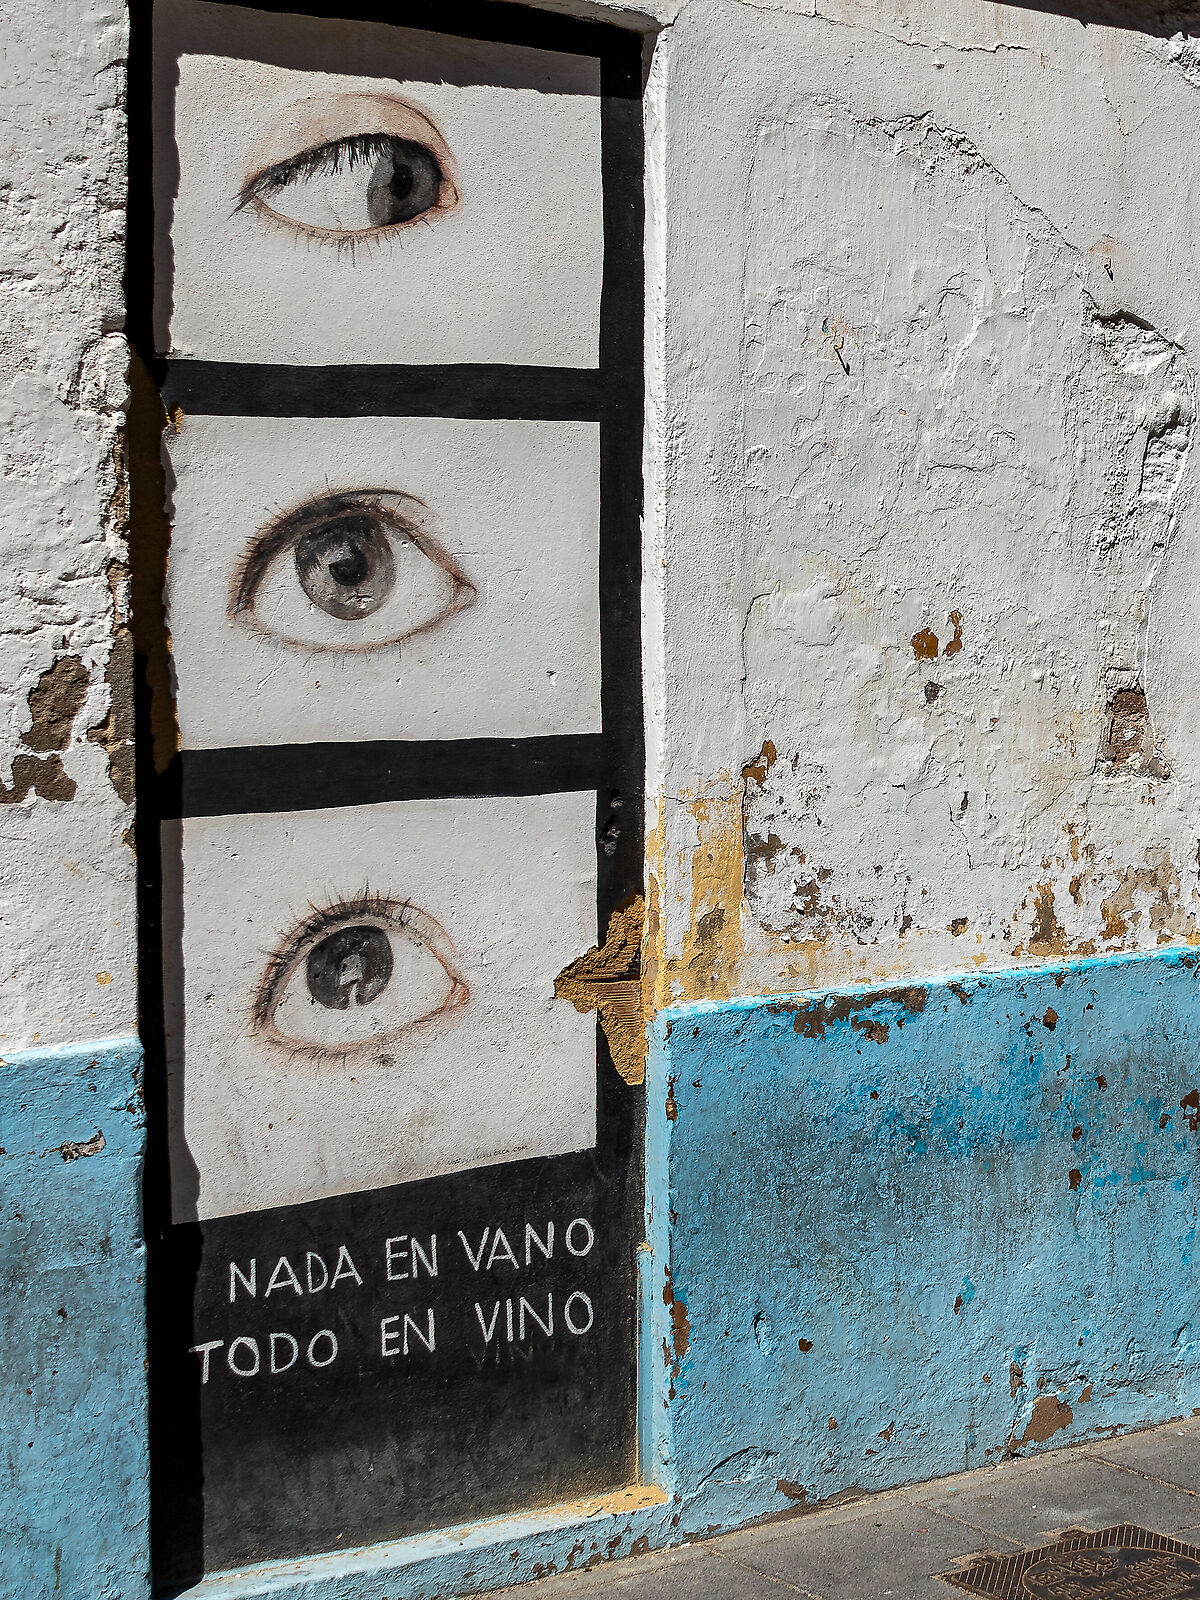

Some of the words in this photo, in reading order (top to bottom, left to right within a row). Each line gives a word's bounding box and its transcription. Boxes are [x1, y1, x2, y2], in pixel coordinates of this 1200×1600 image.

[230, 1245, 363, 1303] NADA
[386, 1234, 438, 1281] EN
[458, 1218, 595, 1271] VANO
[190, 1329, 338, 1383] TODO
[381, 1308, 436, 1356] EN
[475, 1291, 593, 1342] VINO
